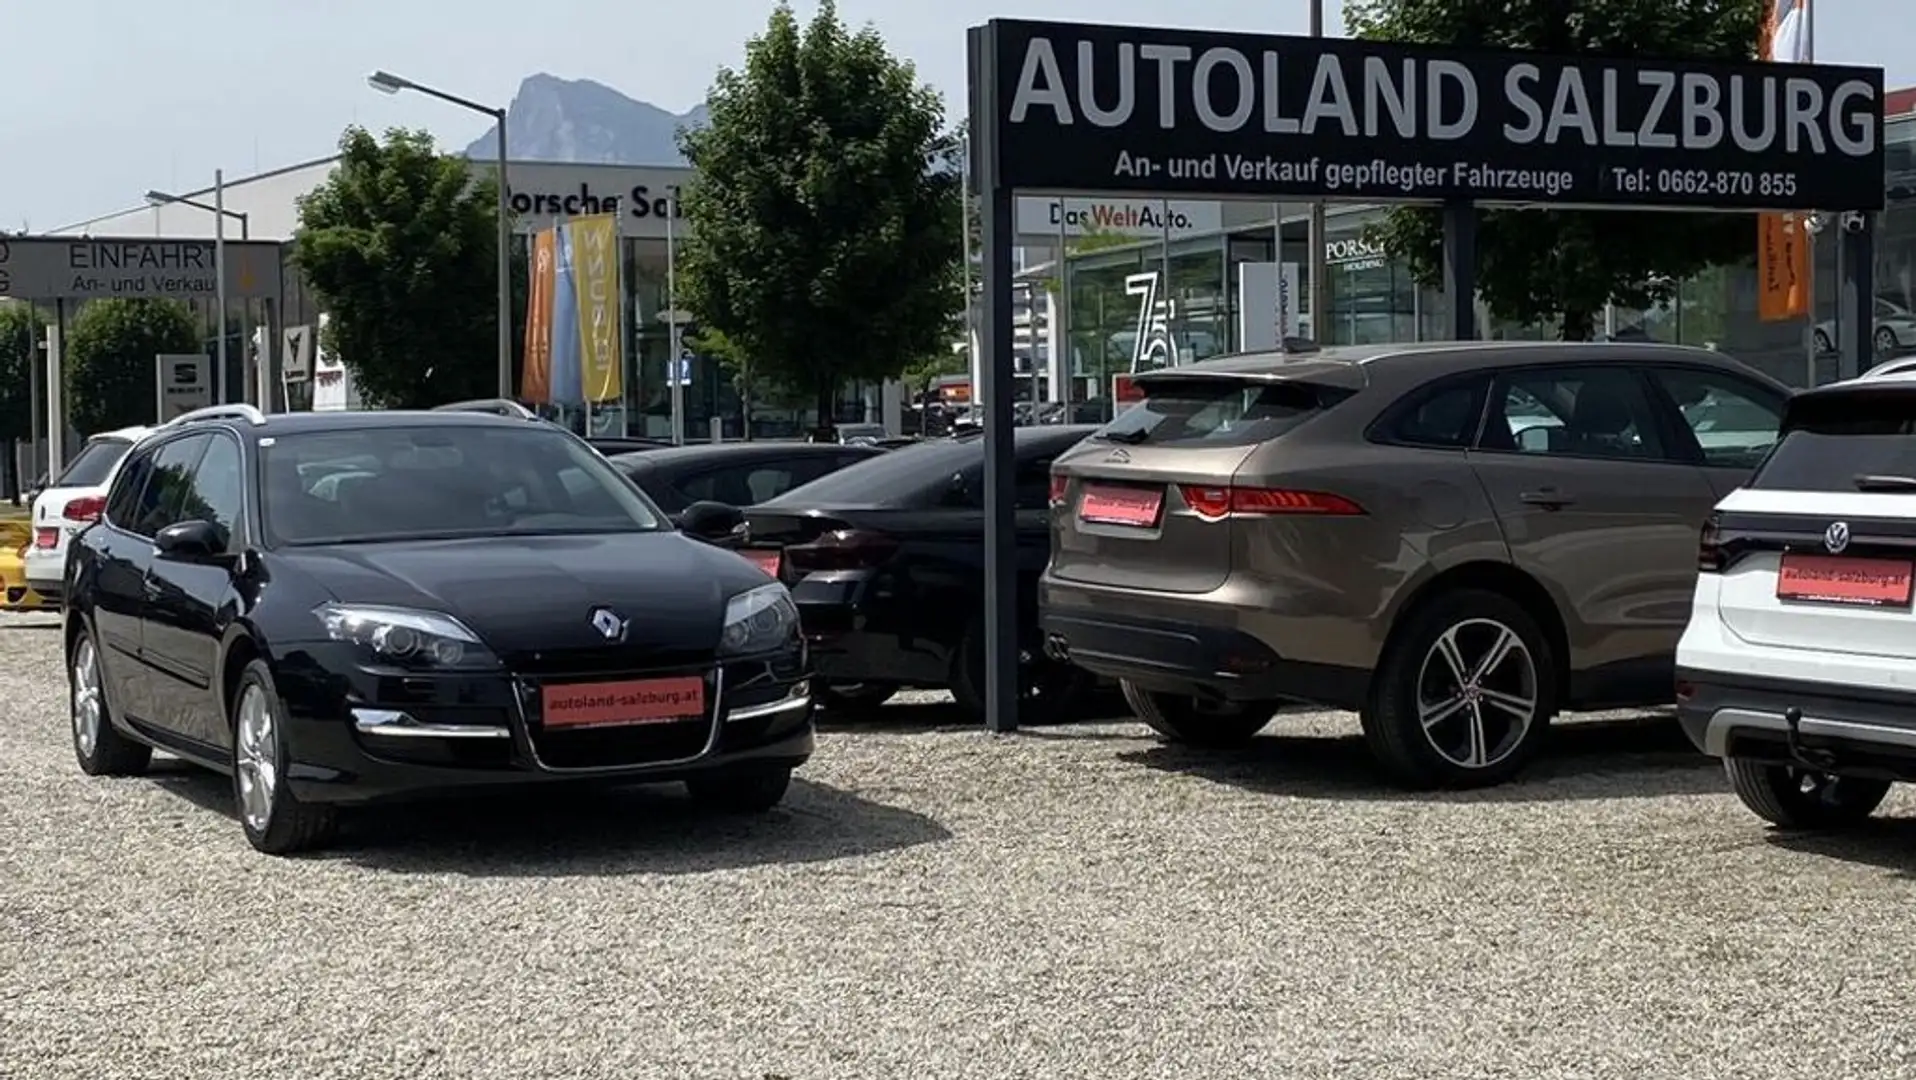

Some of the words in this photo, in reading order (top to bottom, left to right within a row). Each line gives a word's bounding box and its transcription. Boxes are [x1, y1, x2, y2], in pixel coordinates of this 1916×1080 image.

[1009, 37, 1479, 140] AUTOLAND
[1503, 62, 1875, 157] SALZBURG
[1114, 150, 1162, 177] An-
[1168, 154, 1217, 179] und
[1224, 154, 1319, 183] Verkauf
[1325, 160, 1448, 191] gepflegter
[1453, 161, 1574, 195] Fahrzeuge
[1613, 168, 1652, 192] Tel:
[1658, 169, 1754, 195] 0662-870
[1759, 171, 1797, 196] 855
[507, 182, 619, 217] orsche
[72, 275, 104, 292] An-
[111, 275, 145, 292] und
[152, 275, 215, 293] Verkau
[550, 689, 698, 712] autoland-salzburg.at
